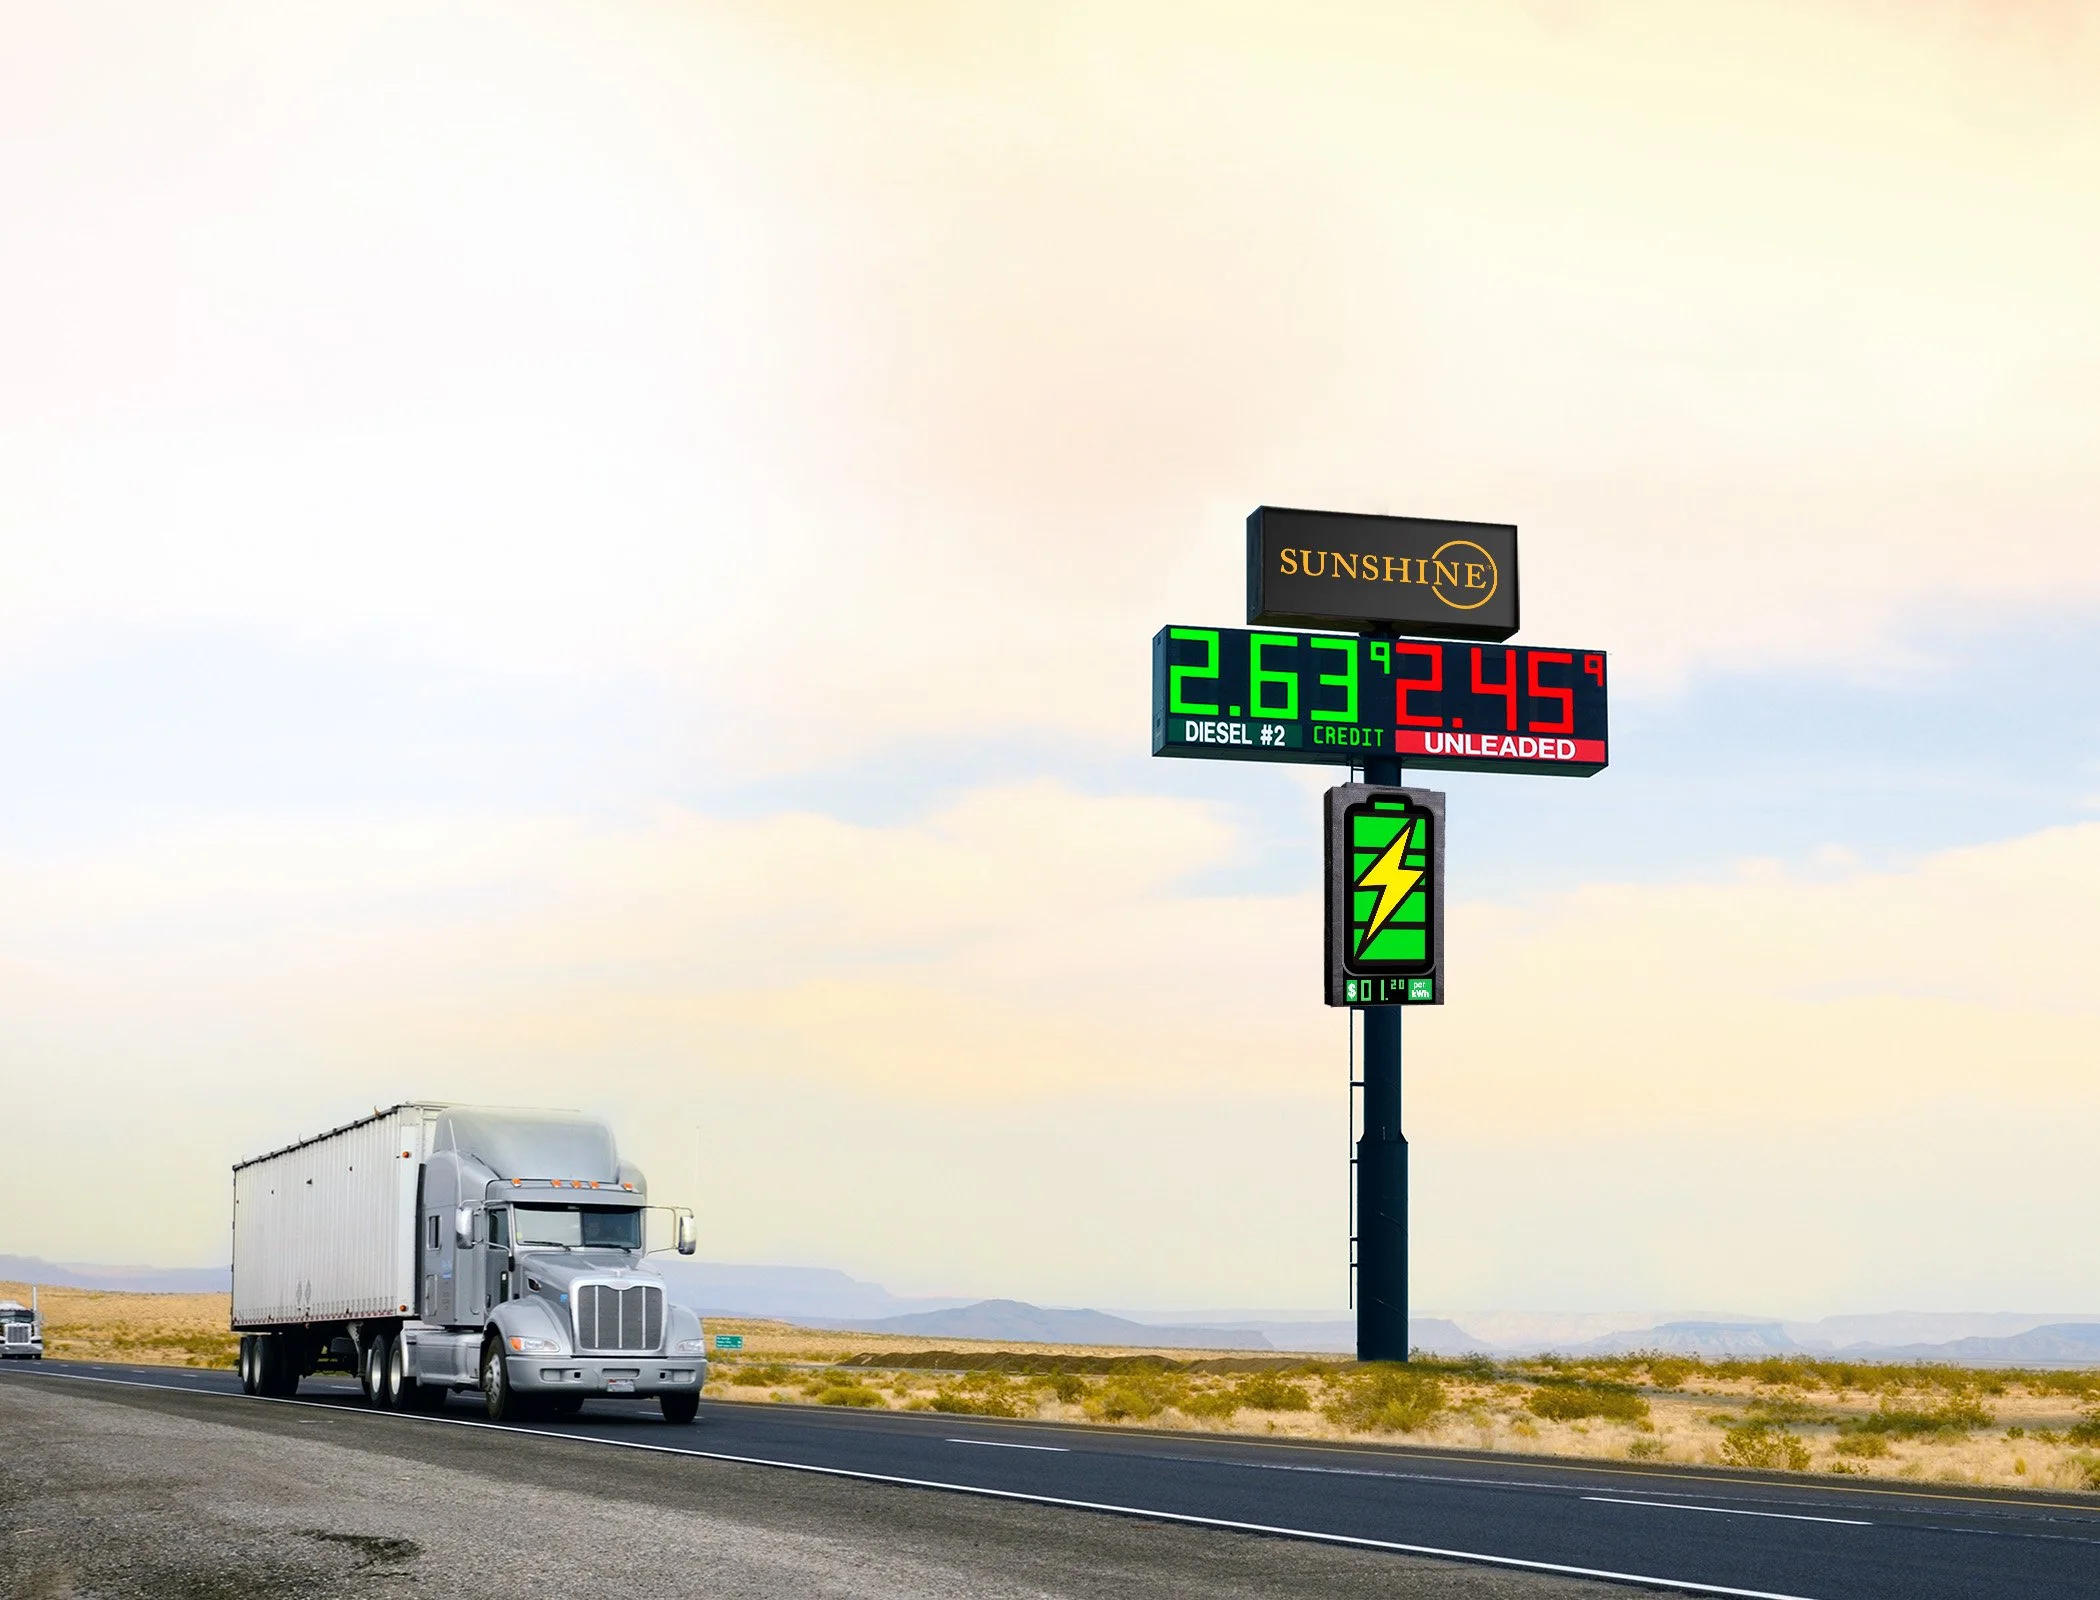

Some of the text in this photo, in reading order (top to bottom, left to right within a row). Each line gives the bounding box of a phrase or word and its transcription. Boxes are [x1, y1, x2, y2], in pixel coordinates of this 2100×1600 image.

[1280, 548, 1487, 590] SUNSHINE
[1185, 720, 1286, 747] DIESEL #2
[1313, 725, 1384, 747] CREDIT
[1424, 731, 1576, 760] UNLEADED
[1411, 990, 1430, 998] kWh
[1413, 982, 1425, 990] per
